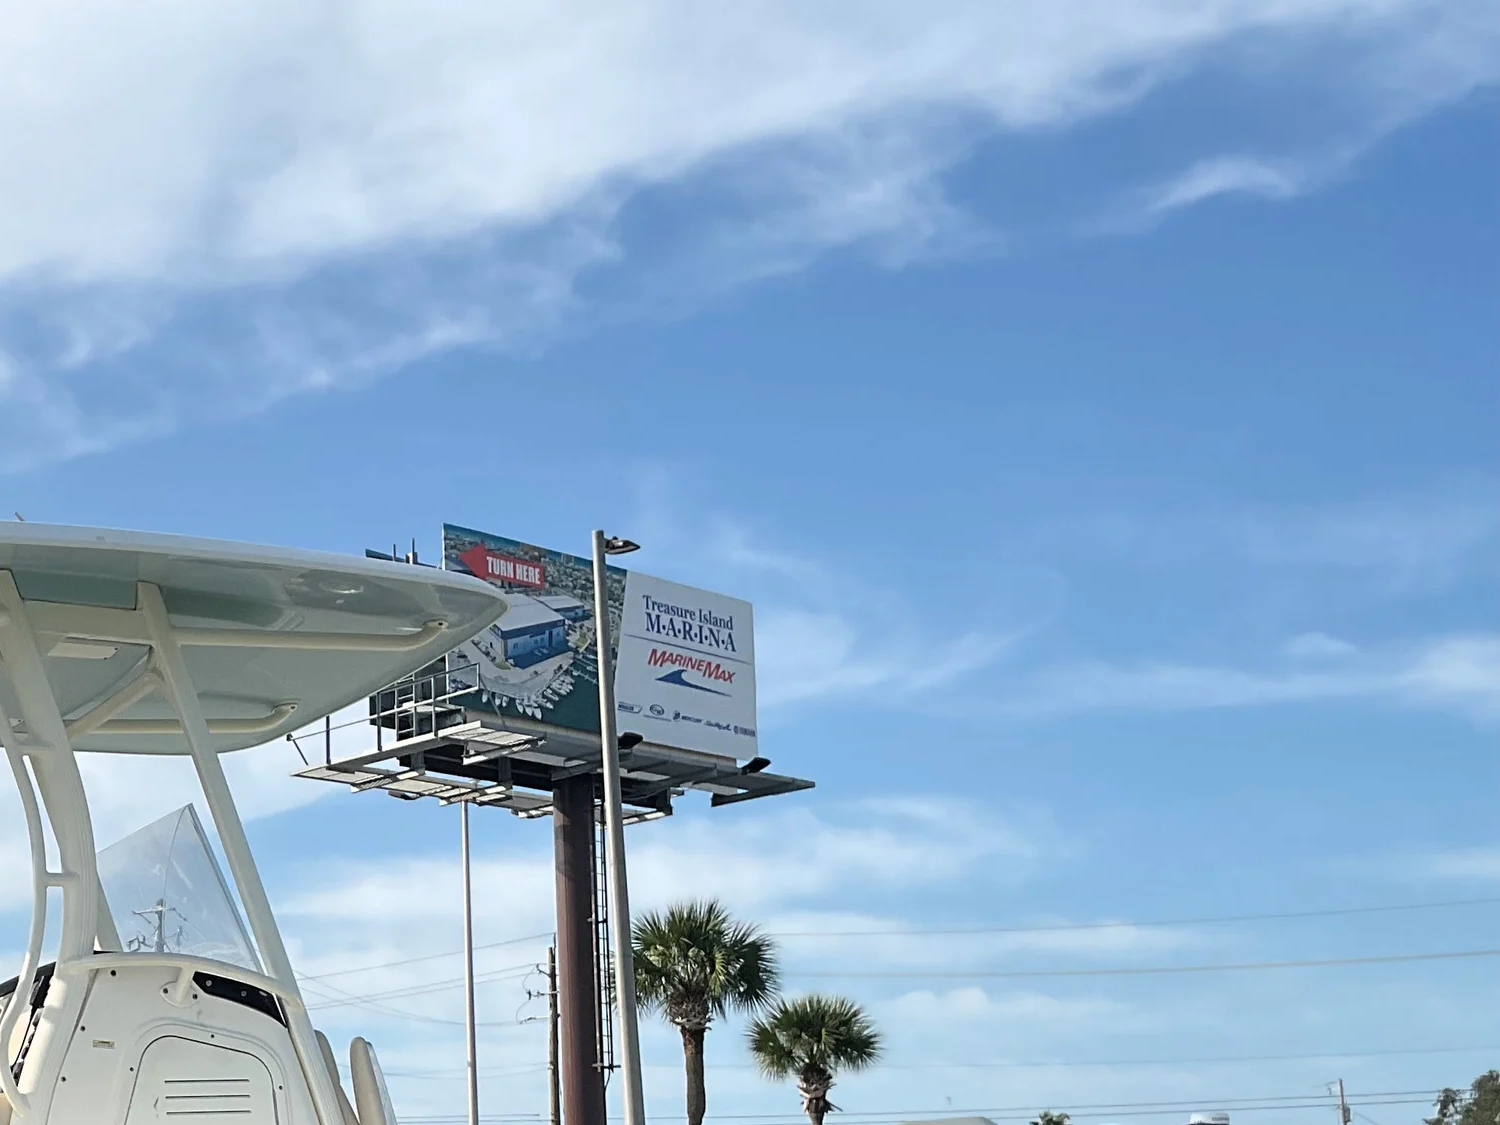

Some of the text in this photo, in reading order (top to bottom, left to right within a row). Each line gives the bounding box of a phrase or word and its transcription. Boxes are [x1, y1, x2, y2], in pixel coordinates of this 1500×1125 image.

[486, 556, 541, 585] TURN HERE
[643, 595, 734, 631] Treasure Island
